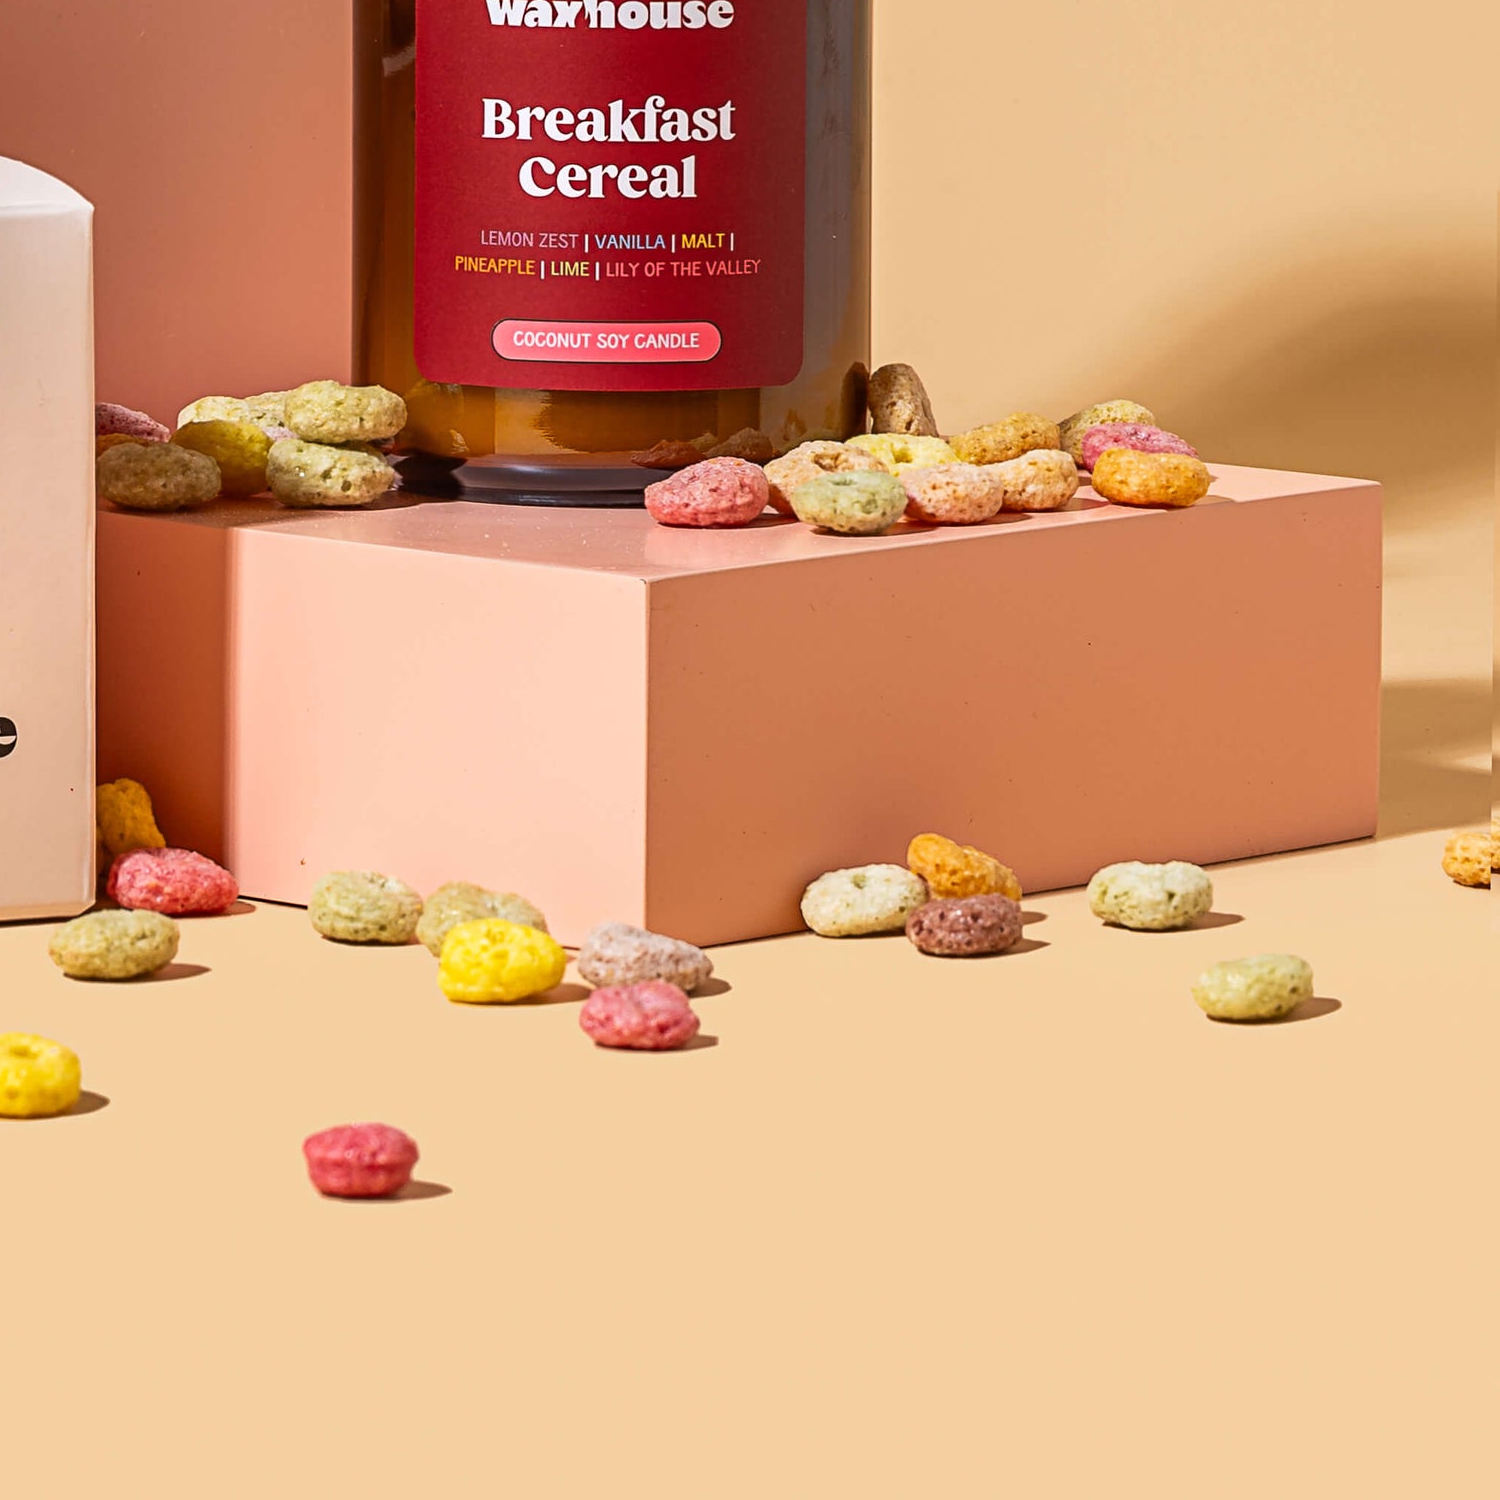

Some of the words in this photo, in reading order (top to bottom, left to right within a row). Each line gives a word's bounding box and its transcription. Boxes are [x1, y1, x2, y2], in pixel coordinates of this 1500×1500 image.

[482, 96, 735, 142] Breakfast
[519, 156, 697, 198] Cereal
[481, 229, 533, 247] LEMON
[538, 232, 578, 249] ZEST
[594, 234, 665, 250] VANILLA
[681, 232, 725, 249] MALT
[453, 255, 535, 276] PINEAPPLE
[550, 260, 589, 277] LIME
[606, 261, 639, 278] LILY
[644, 261, 665, 278] OF
[669, 261, 701, 277] THE
[705, 258, 760, 276] VALLEY
[512, 330, 591, 349] COCONUT
[596, 333, 629, 349] SOY
[633, 332, 699, 349] CANDLE
